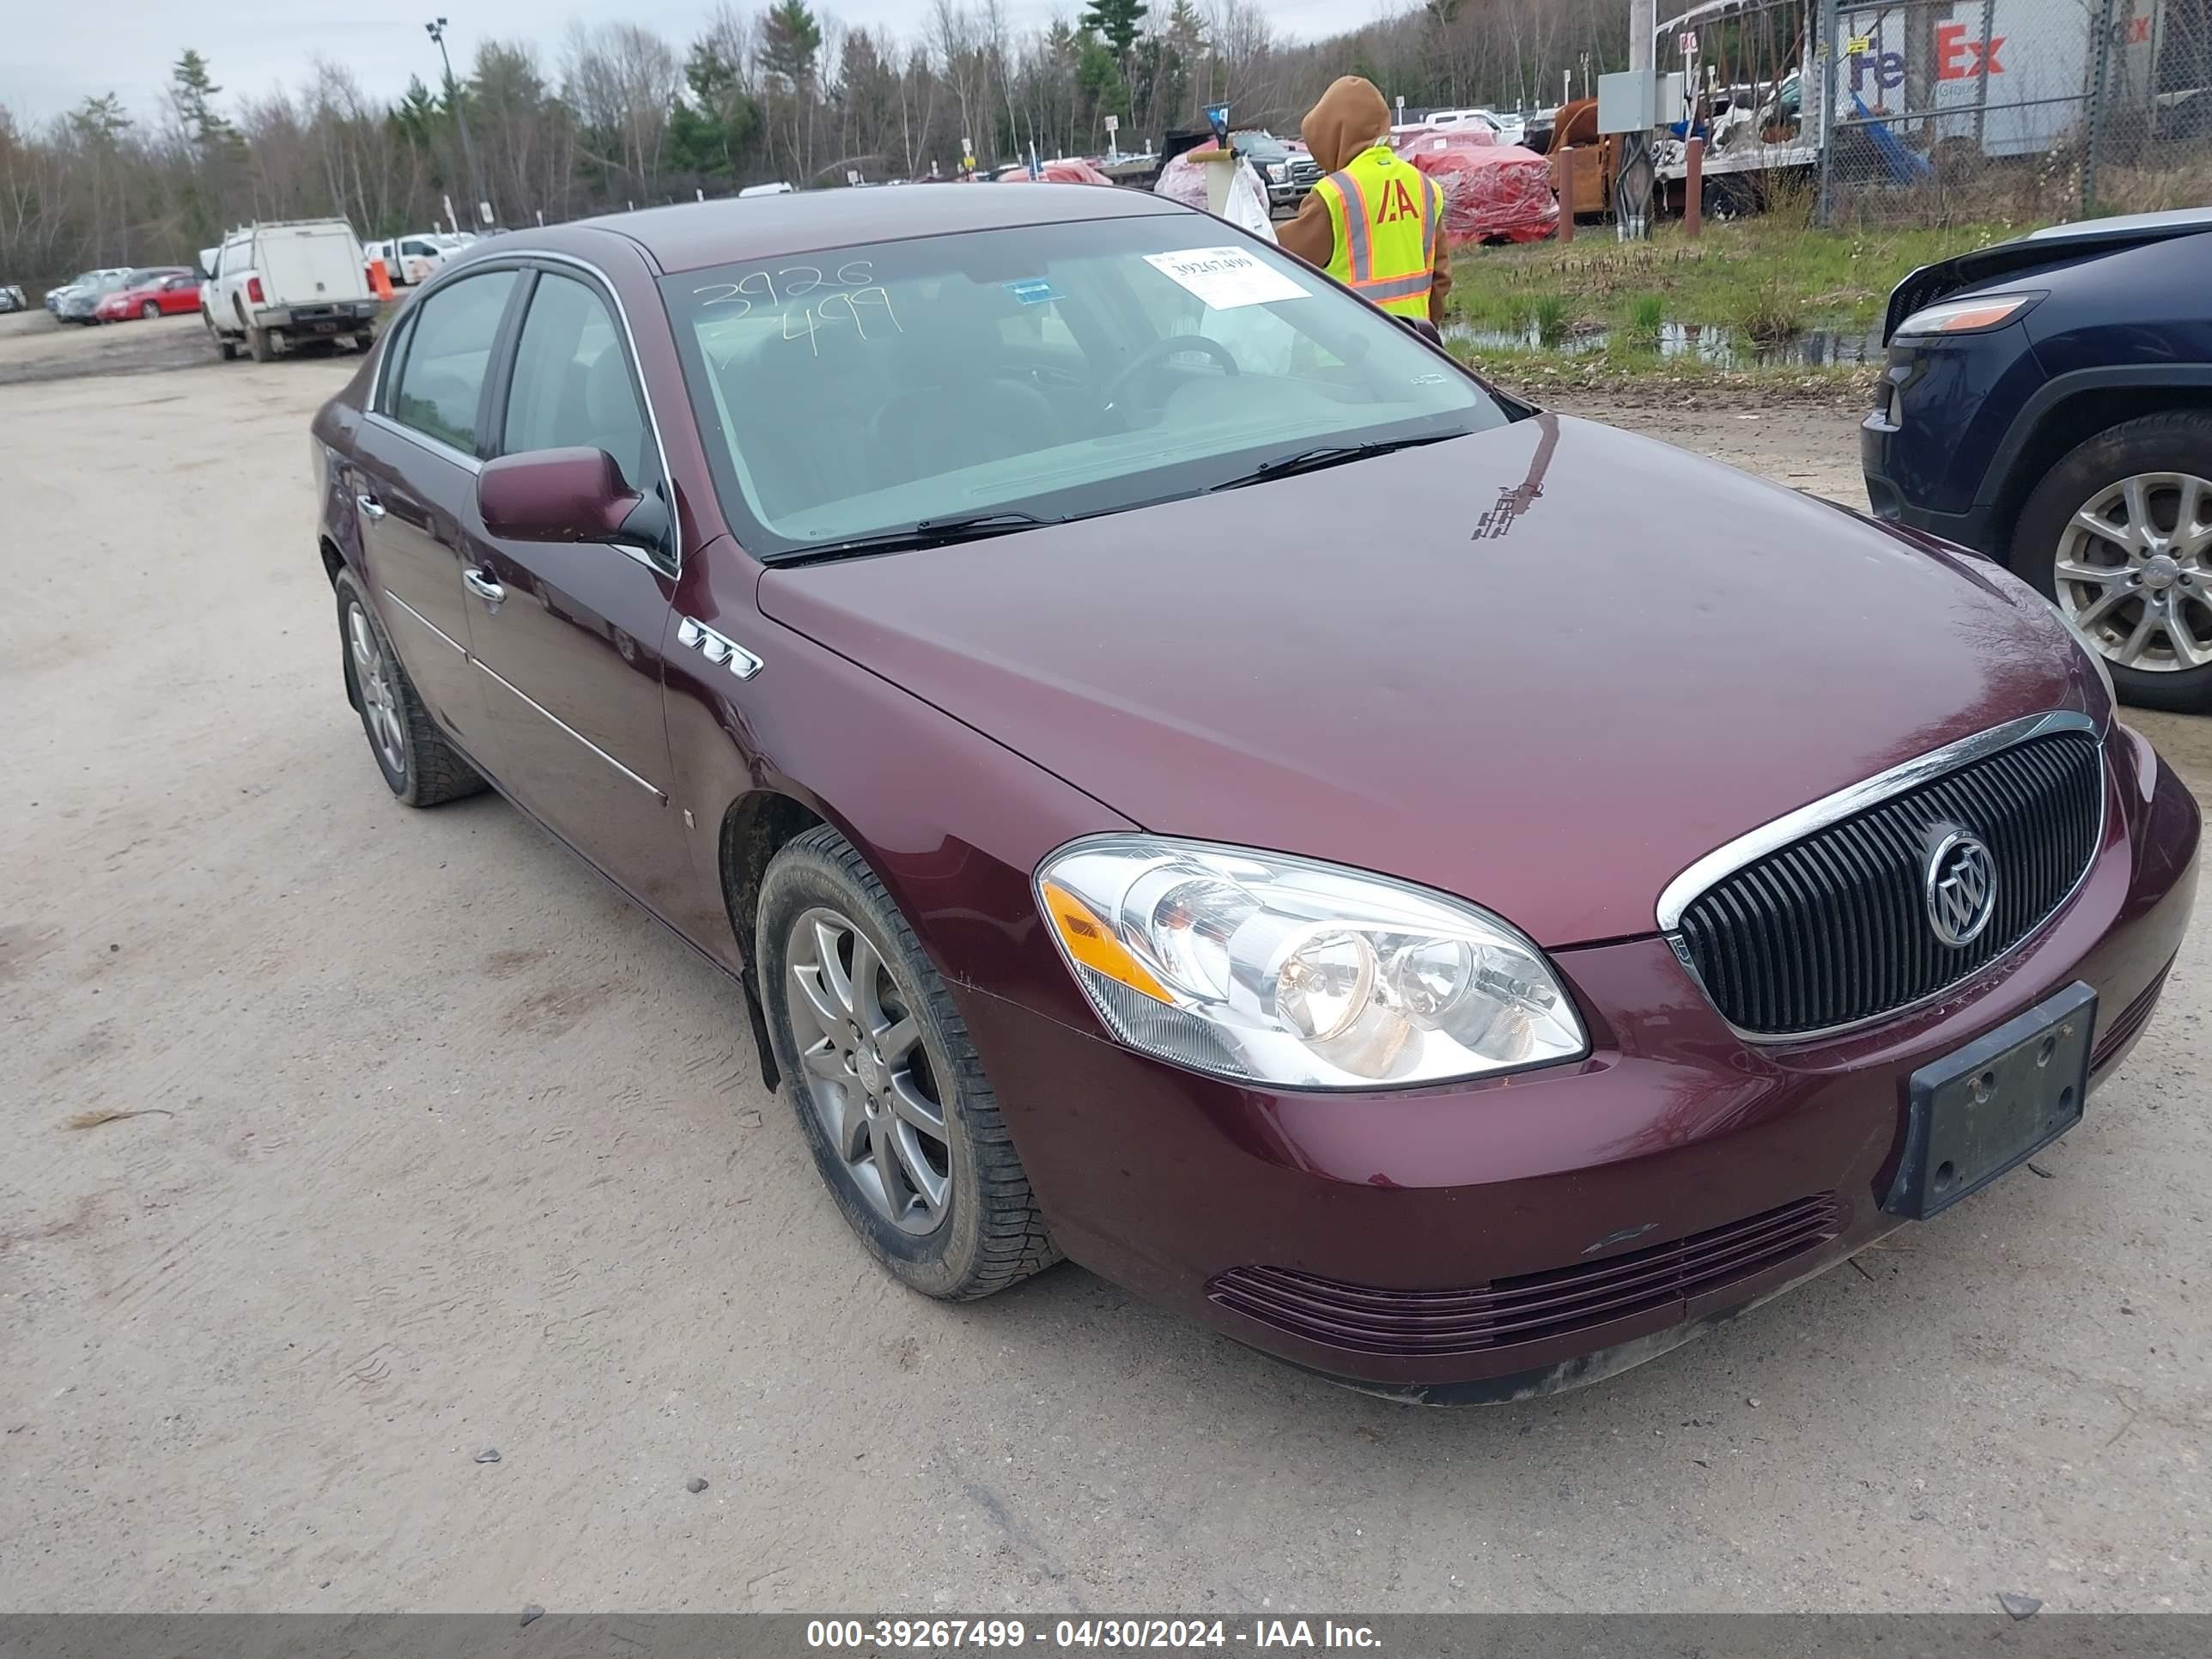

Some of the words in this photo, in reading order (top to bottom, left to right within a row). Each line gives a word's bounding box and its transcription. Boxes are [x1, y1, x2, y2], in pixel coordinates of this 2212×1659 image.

[693, 261, 873, 321] 3926
[1171, 258, 1253, 276] 39267499
[782, 287, 905, 357] 499
